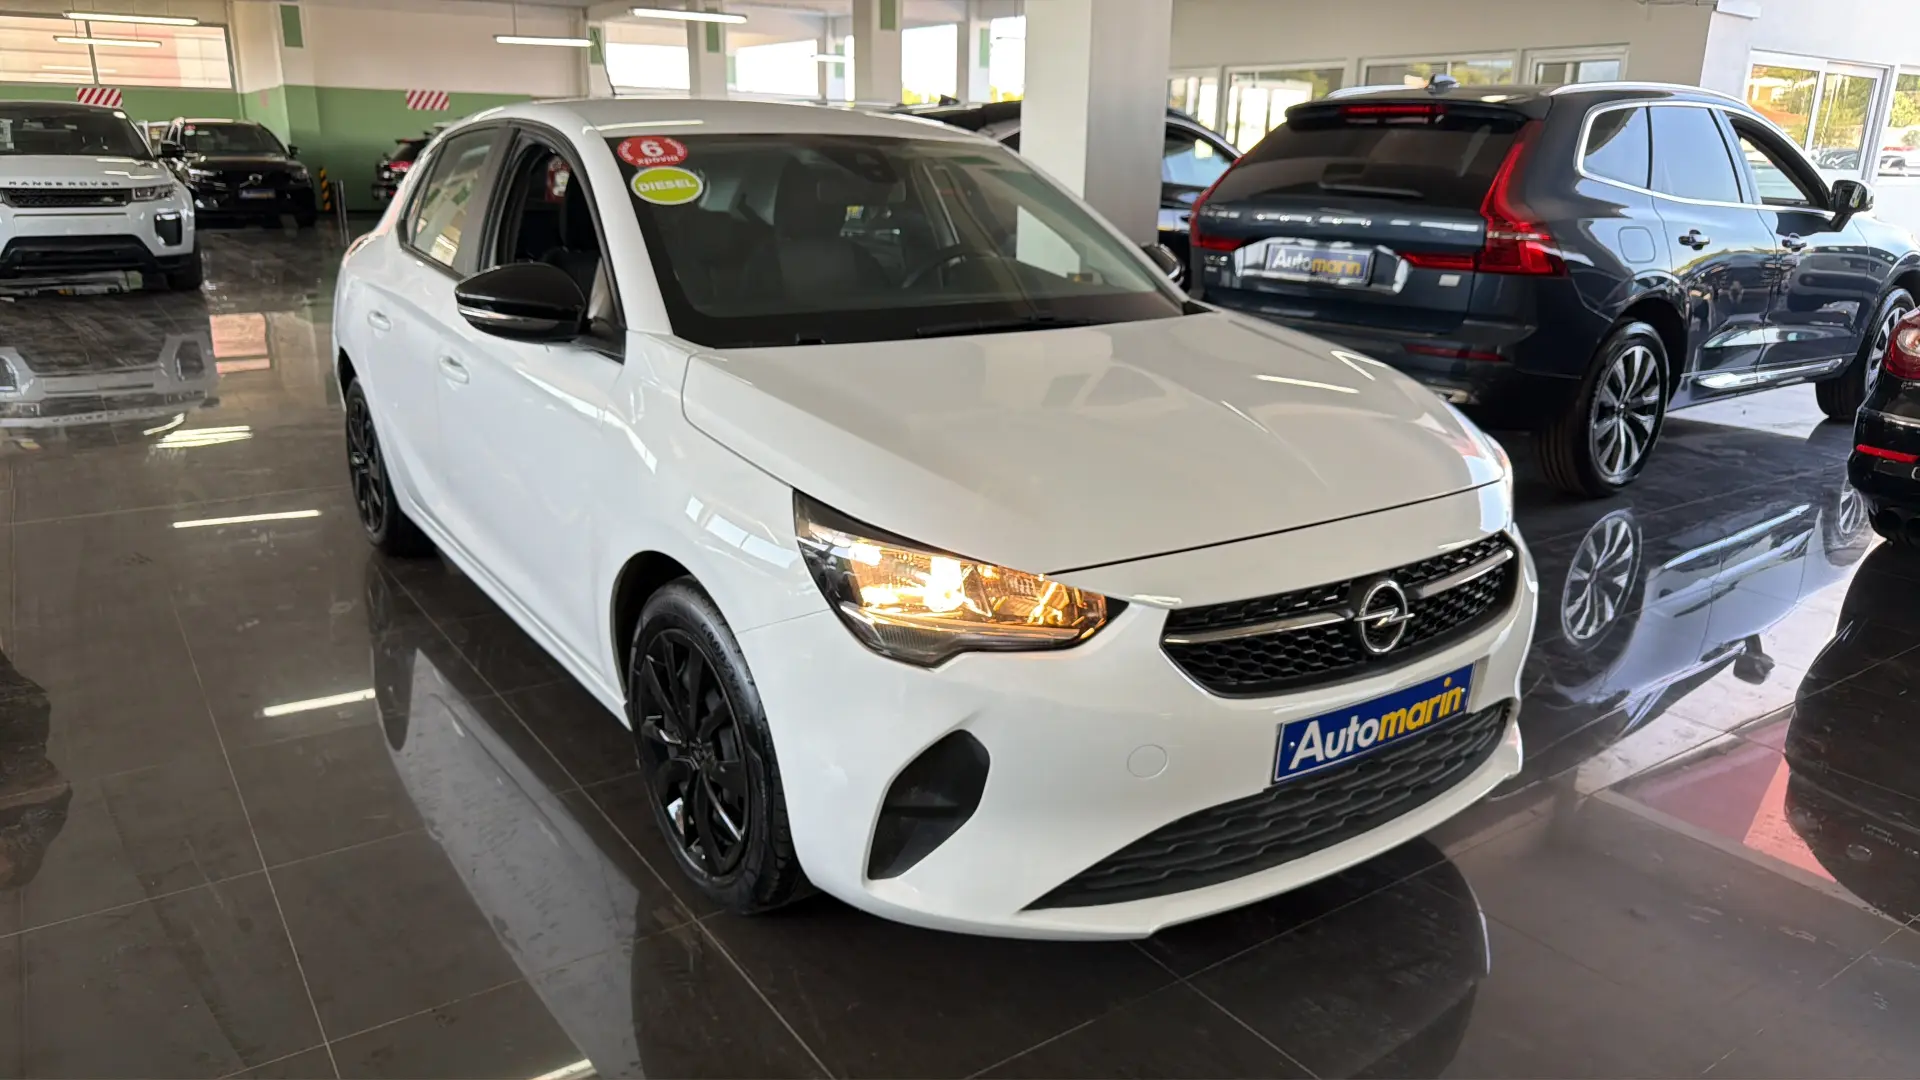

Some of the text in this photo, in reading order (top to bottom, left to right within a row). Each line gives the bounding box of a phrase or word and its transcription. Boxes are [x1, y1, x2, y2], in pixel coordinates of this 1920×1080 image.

[640, 140, 664, 157] 6
[638, 178, 697, 193] DIESEL
[1271, 248, 1361, 276] Automarin
[1288, 676, 1463, 770] Automarin
